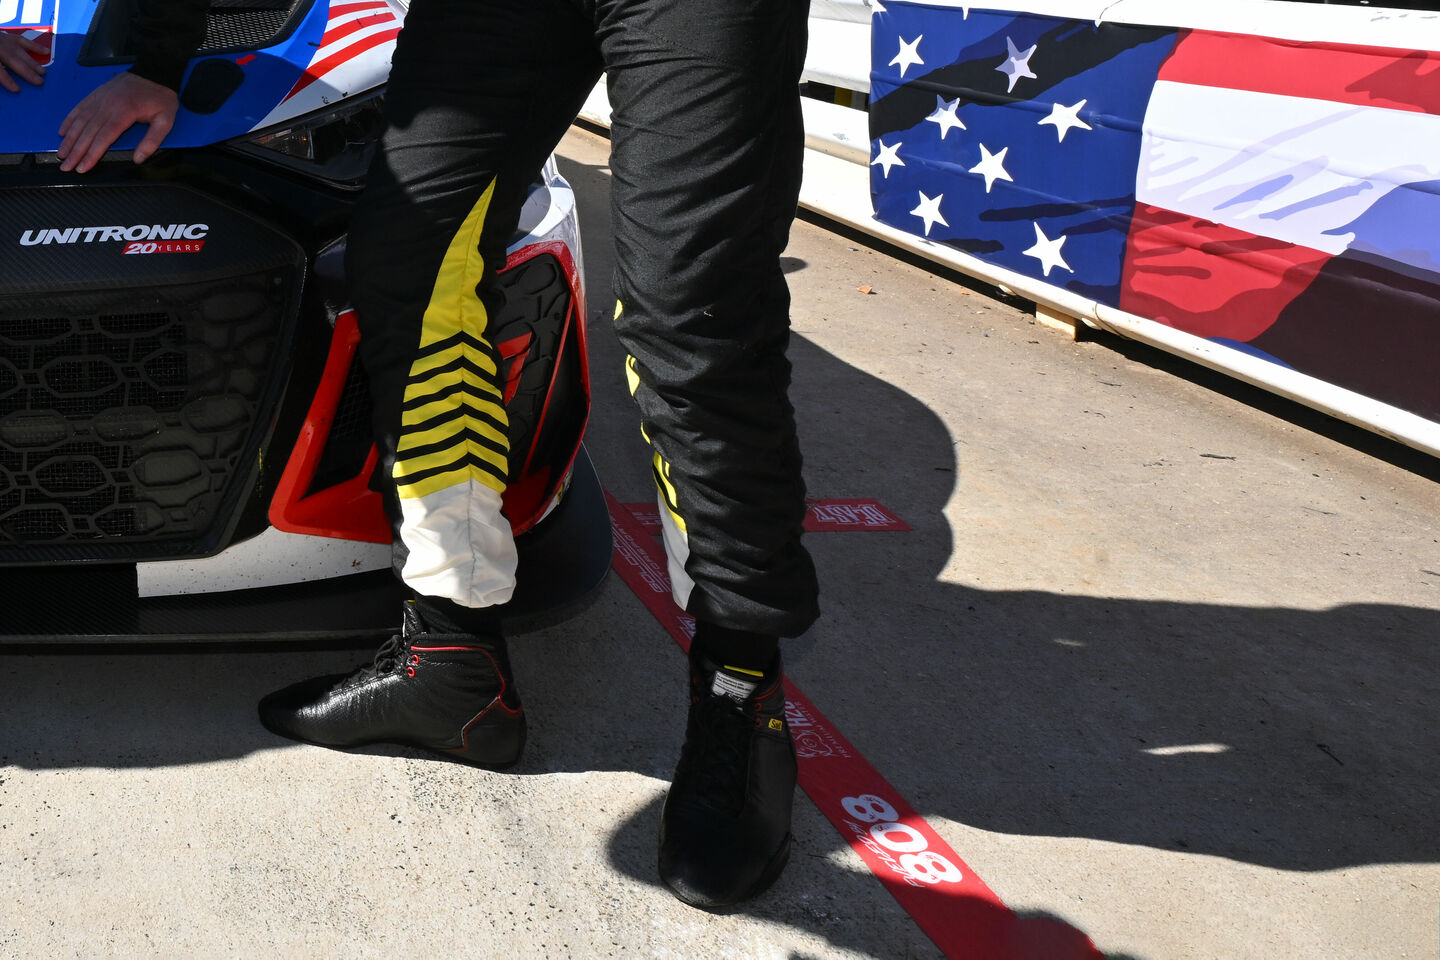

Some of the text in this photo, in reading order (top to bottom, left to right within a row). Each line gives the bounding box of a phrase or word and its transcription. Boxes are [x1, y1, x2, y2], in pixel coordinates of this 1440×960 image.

[19, 223, 209, 246] UNITRONIC
[124, 243, 200, 254] 20 YEARS
[841, 794, 962, 884] 808
